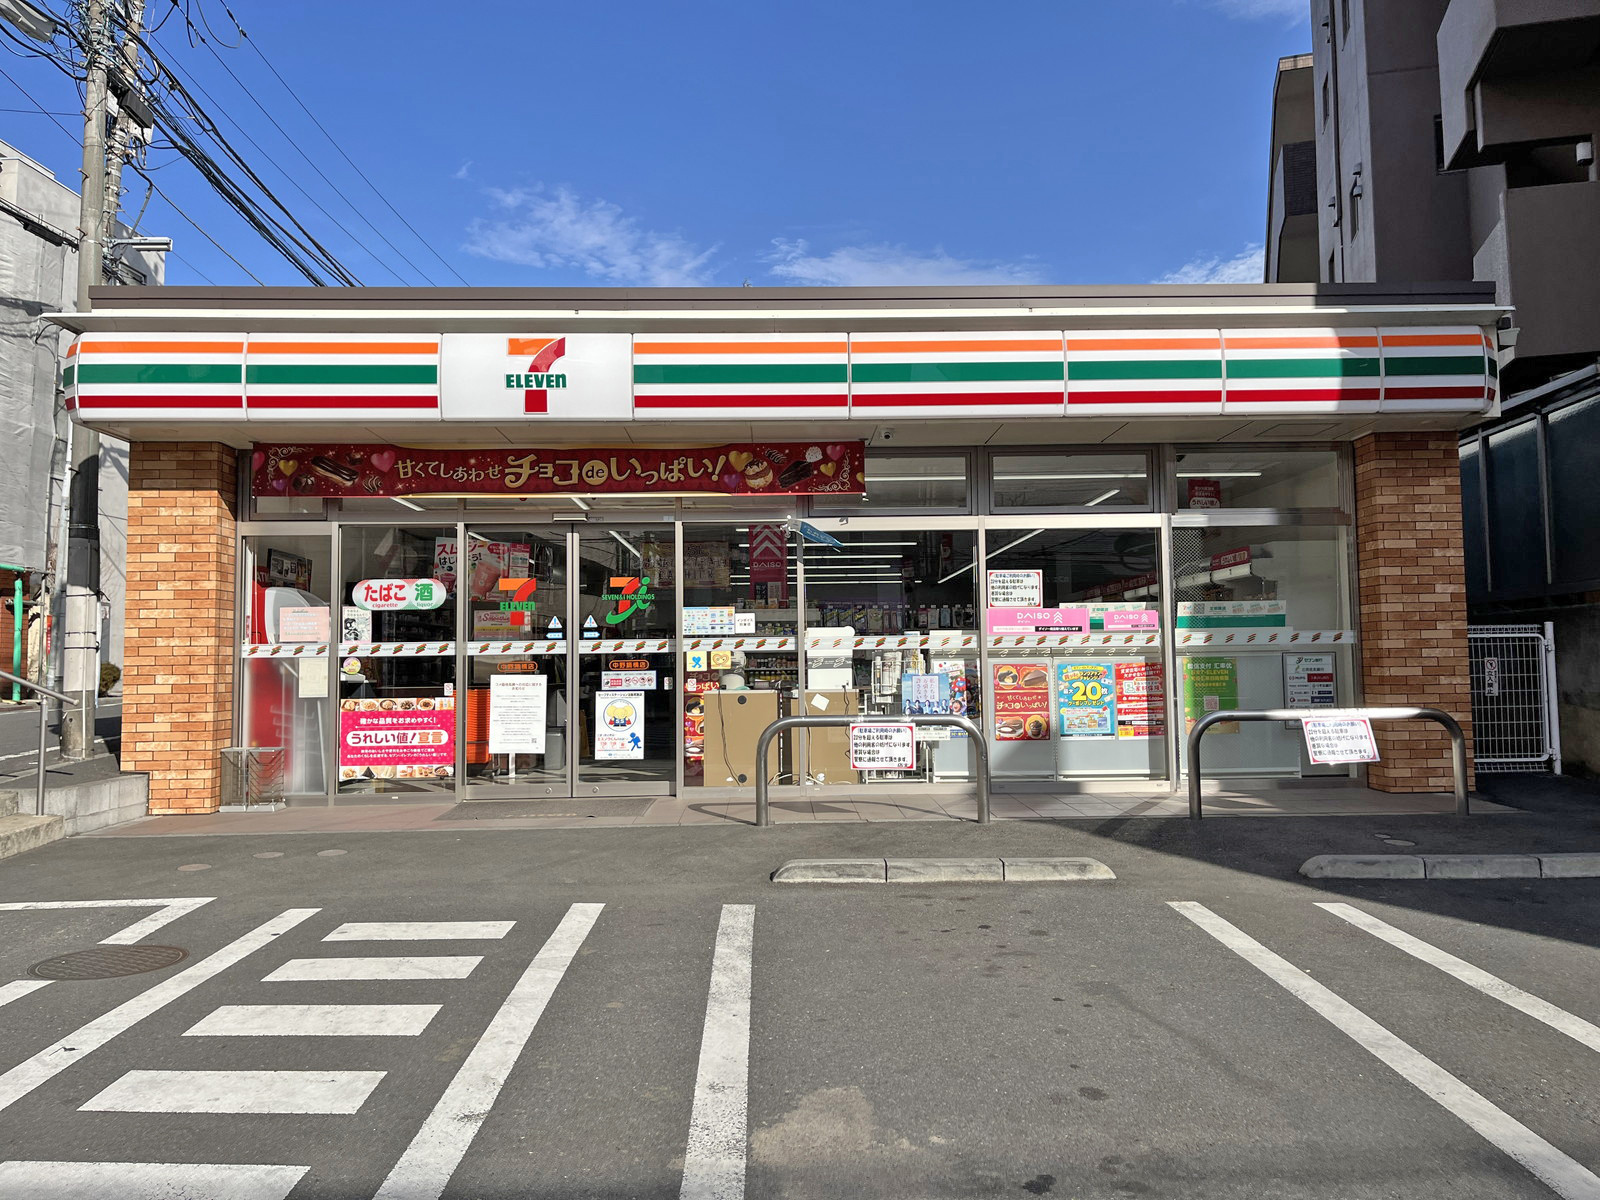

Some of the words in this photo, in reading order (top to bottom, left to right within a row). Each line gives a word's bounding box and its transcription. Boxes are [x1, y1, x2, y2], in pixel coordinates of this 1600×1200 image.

[394, 458, 503, 483] 甘くてしあわせ
[364, 583, 406, 602] たばこ
[415, 583, 433, 601] 酒
